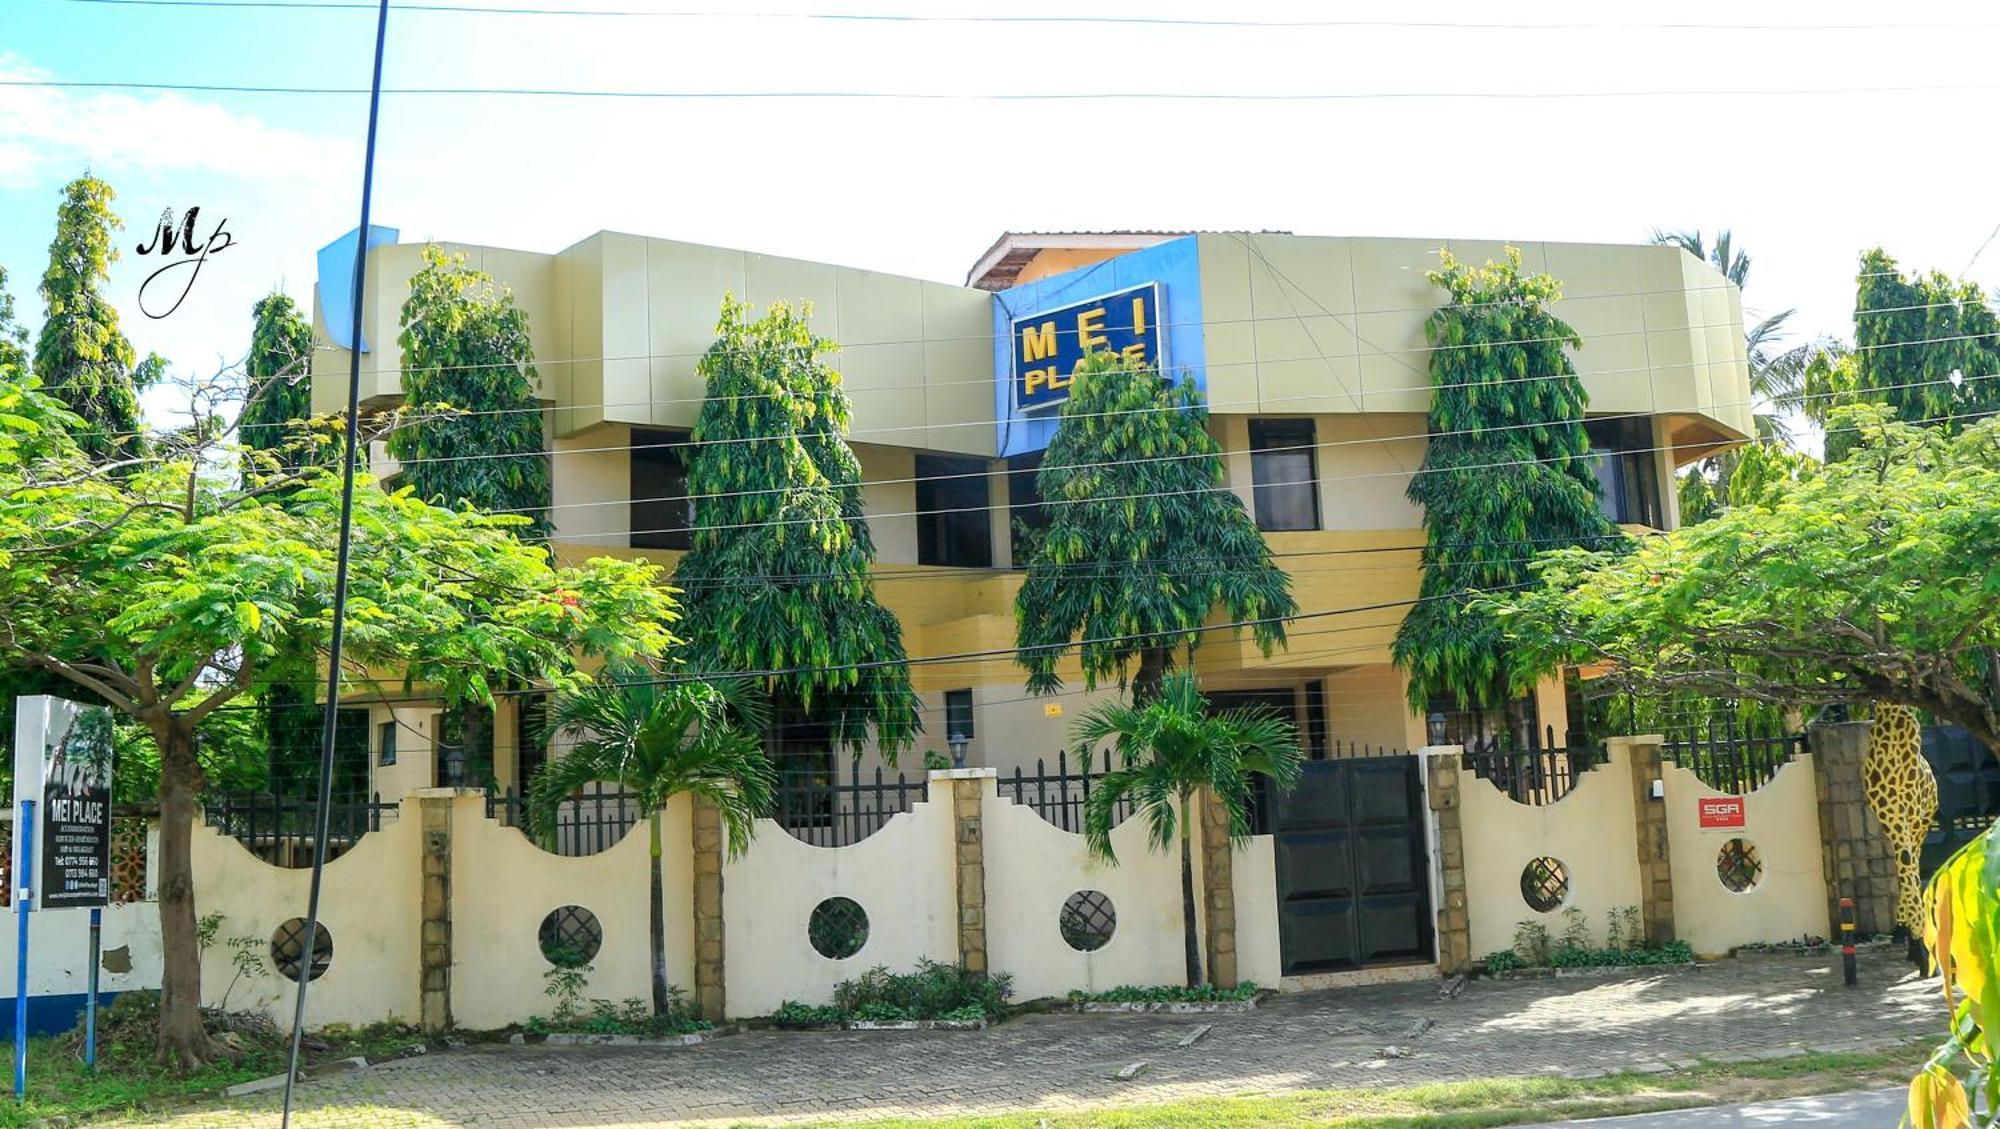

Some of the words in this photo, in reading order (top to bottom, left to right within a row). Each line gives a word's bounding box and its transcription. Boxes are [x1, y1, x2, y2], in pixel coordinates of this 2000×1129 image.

[1022, 298, 1146, 363] MEI
[1024, 342, 1146, 395] PLAE
[52, 799, 70, 822] MEI
[72, 800, 103, 825] PLACE
[1704, 804, 1739, 814] SGA
